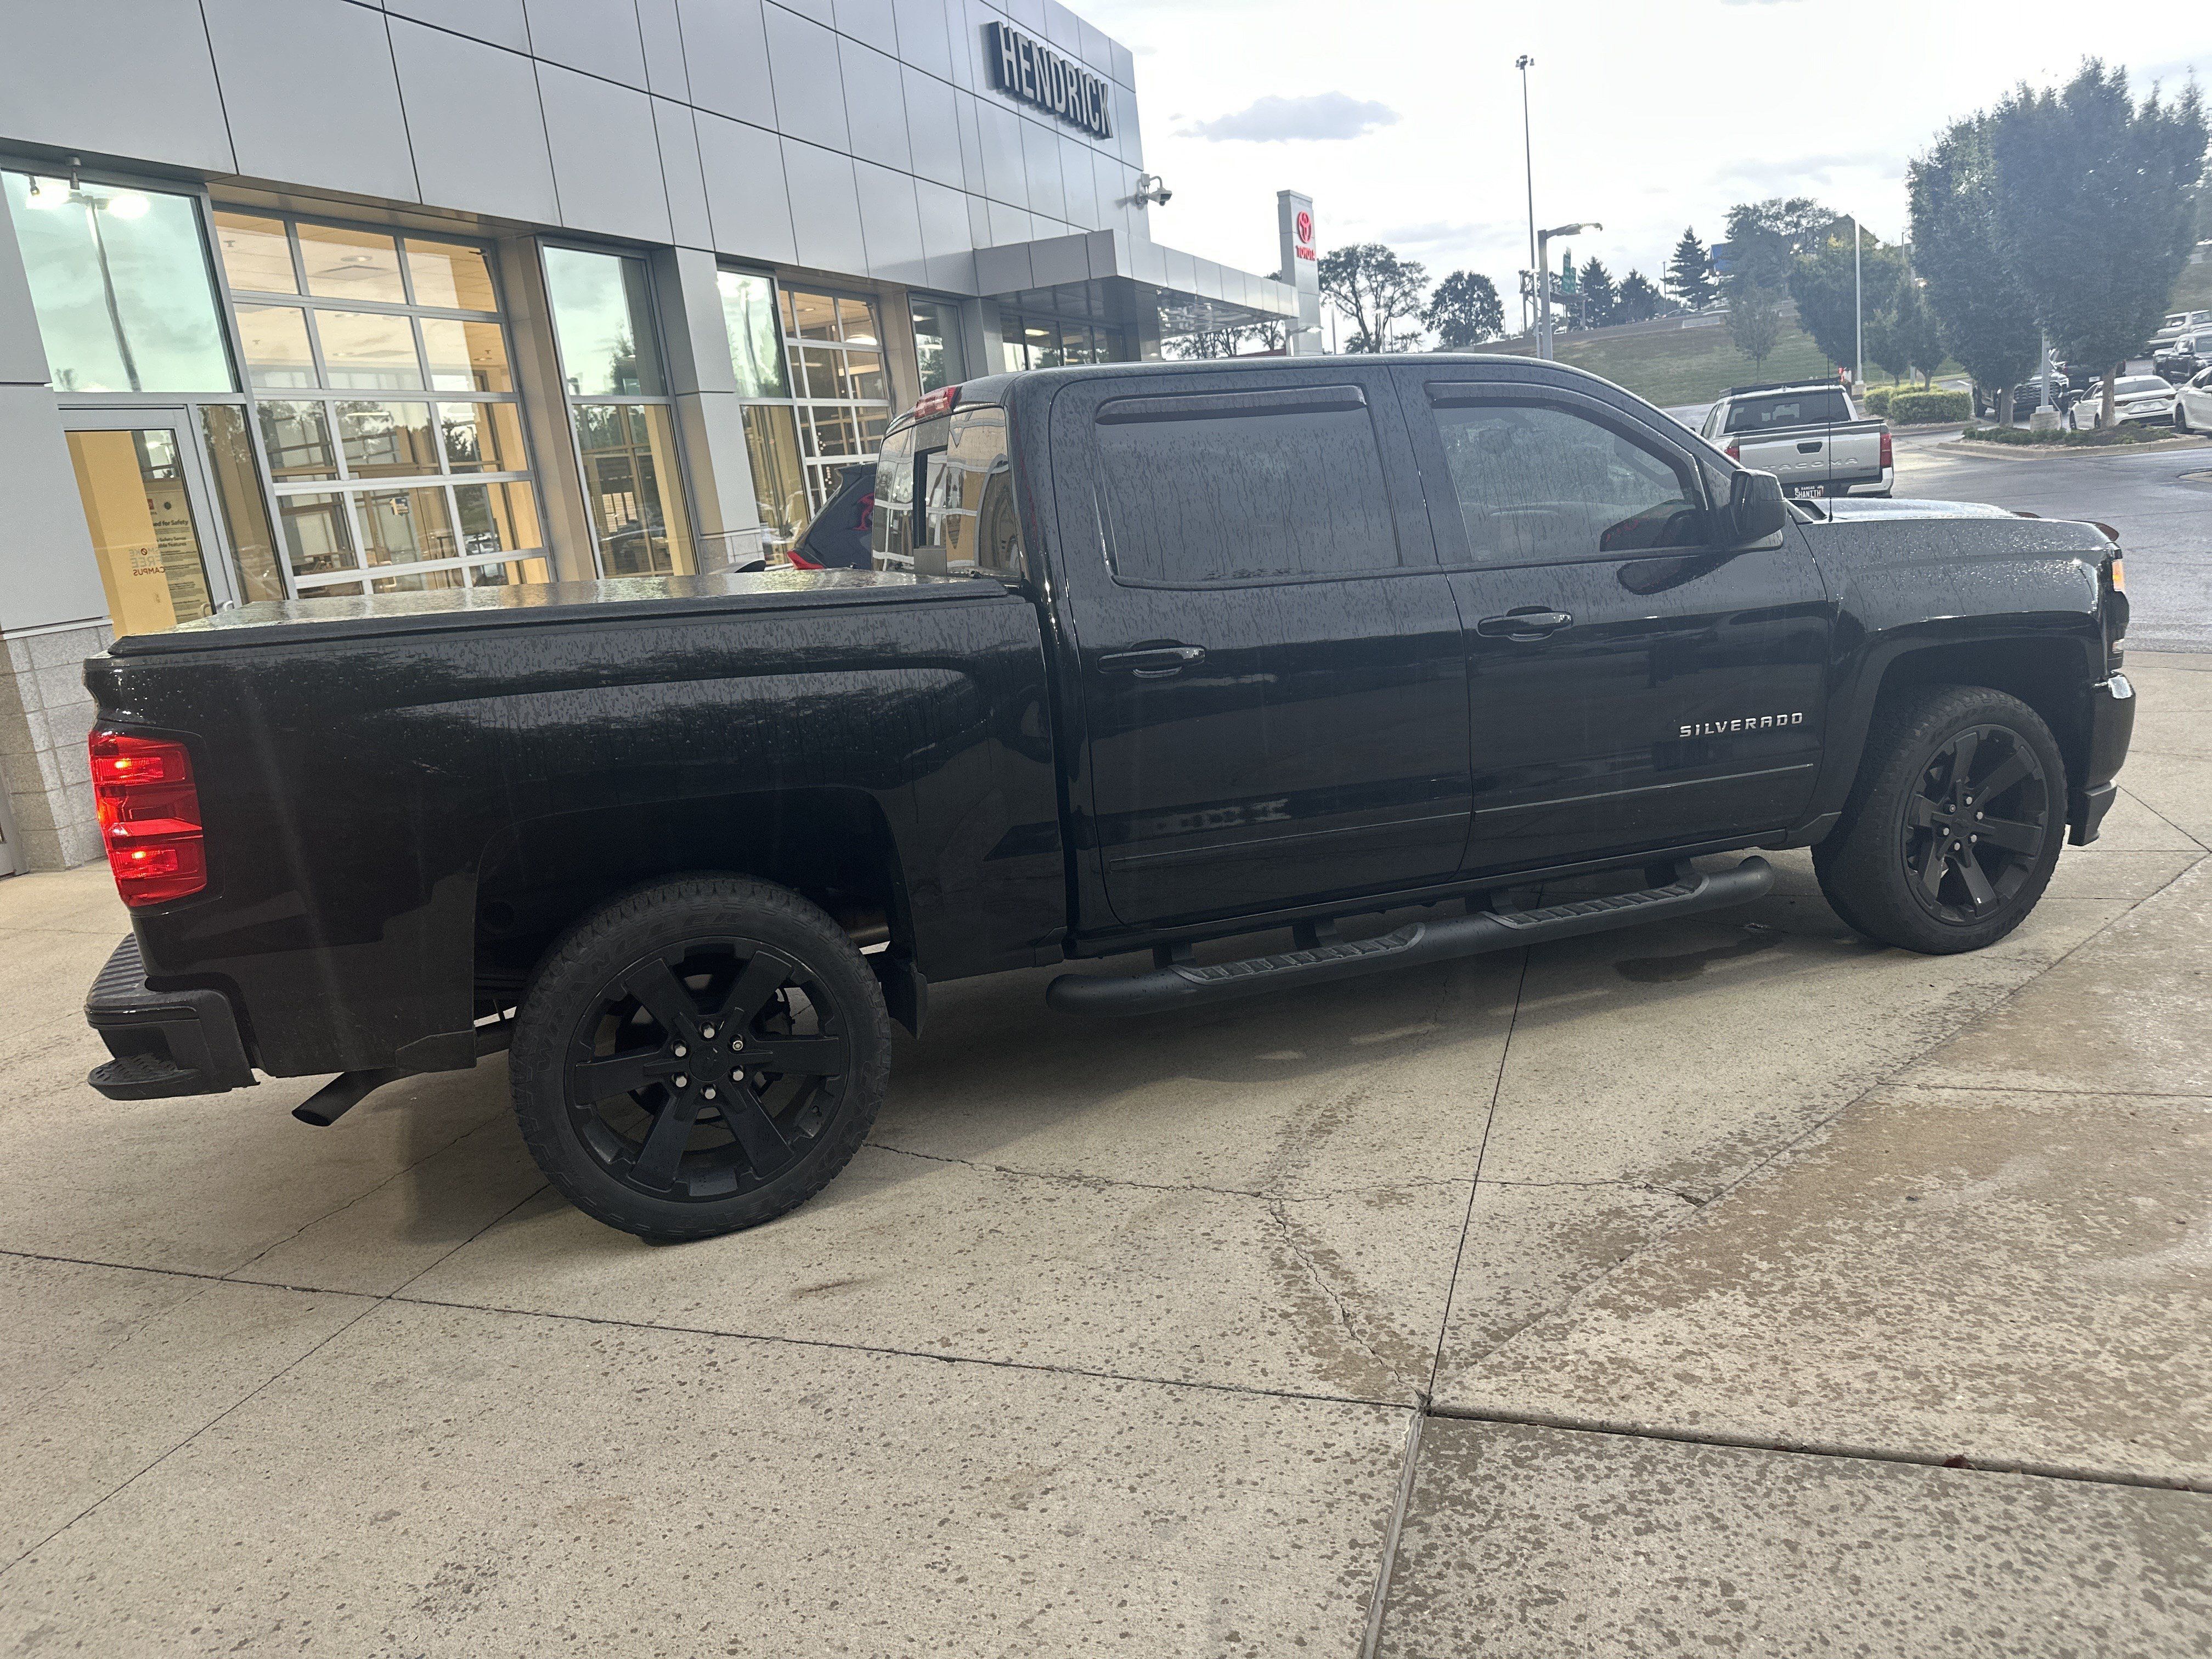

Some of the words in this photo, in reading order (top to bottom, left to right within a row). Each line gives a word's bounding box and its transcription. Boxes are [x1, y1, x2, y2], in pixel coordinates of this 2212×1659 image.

[991, 21, 1113, 139] HENDRICK
[1295, 245, 1316, 261] TOYOTA
[1760, 458, 1858, 471] TACOMA
[1679, 712, 1803, 738] SILVERADO
